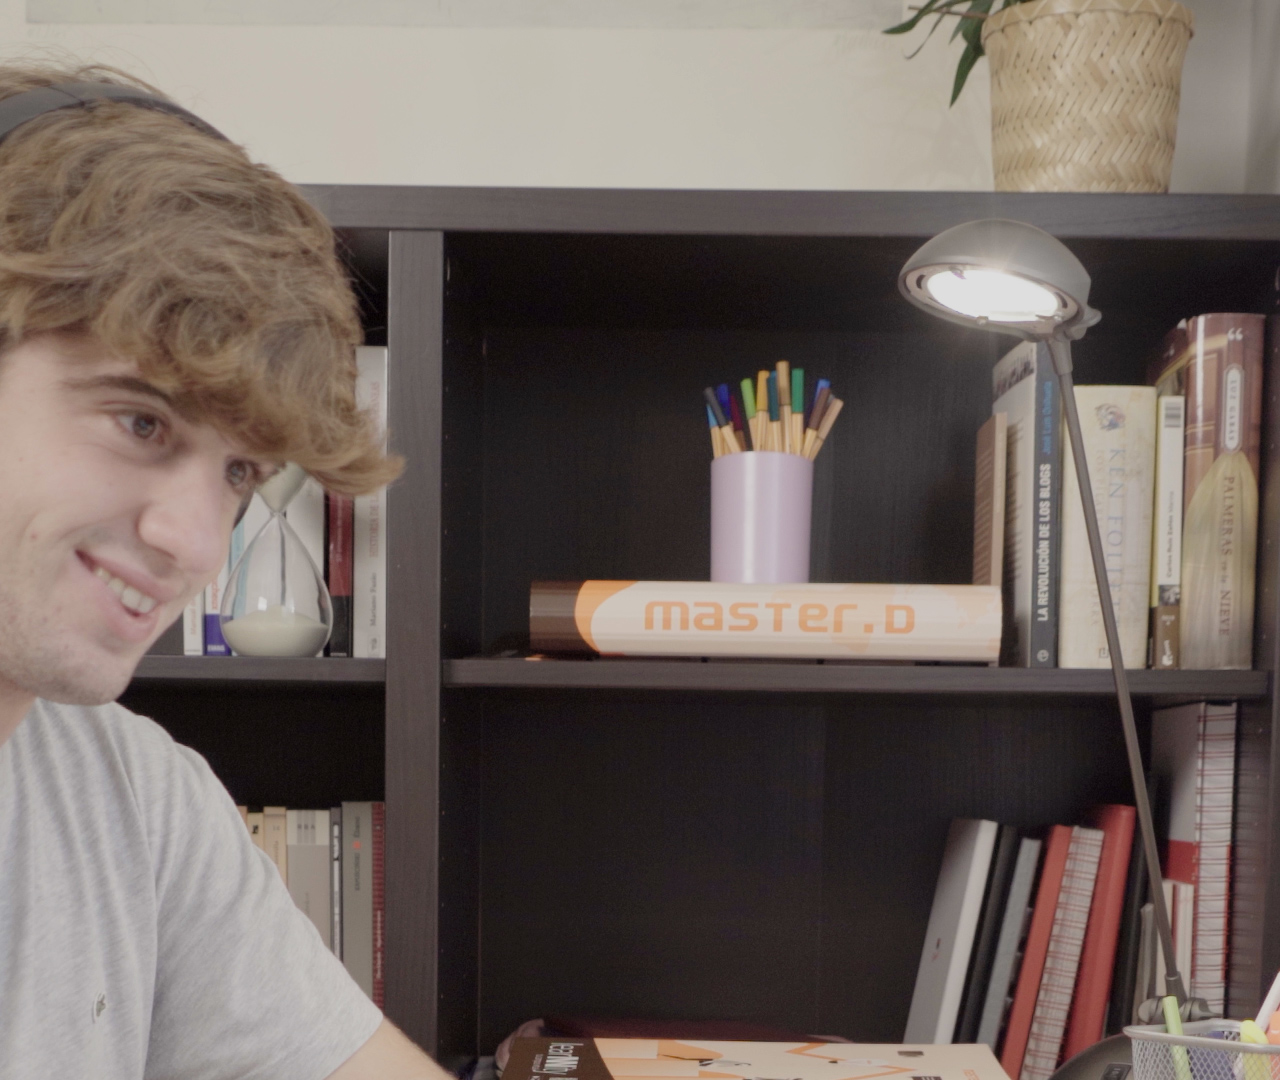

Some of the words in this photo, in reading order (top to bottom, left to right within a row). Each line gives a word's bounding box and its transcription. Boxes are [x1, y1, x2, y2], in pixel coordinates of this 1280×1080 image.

[1039, 463, 1052, 499] BLOGS
[1109, 448, 1126, 498] KEN
[1038, 500, 1051, 522] LOS
[1038, 523, 1051, 539] DE
[1220, 476, 1235, 557] PALMERAS
[1035, 539, 1051, 606] REVOLUCIÓN
[1106, 515, 1124, 629] FOLLET
[644, 601, 915, 634] master.D
[1037, 607, 1049, 622] LA
[1218, 589, 1232, 637] NIEVE
